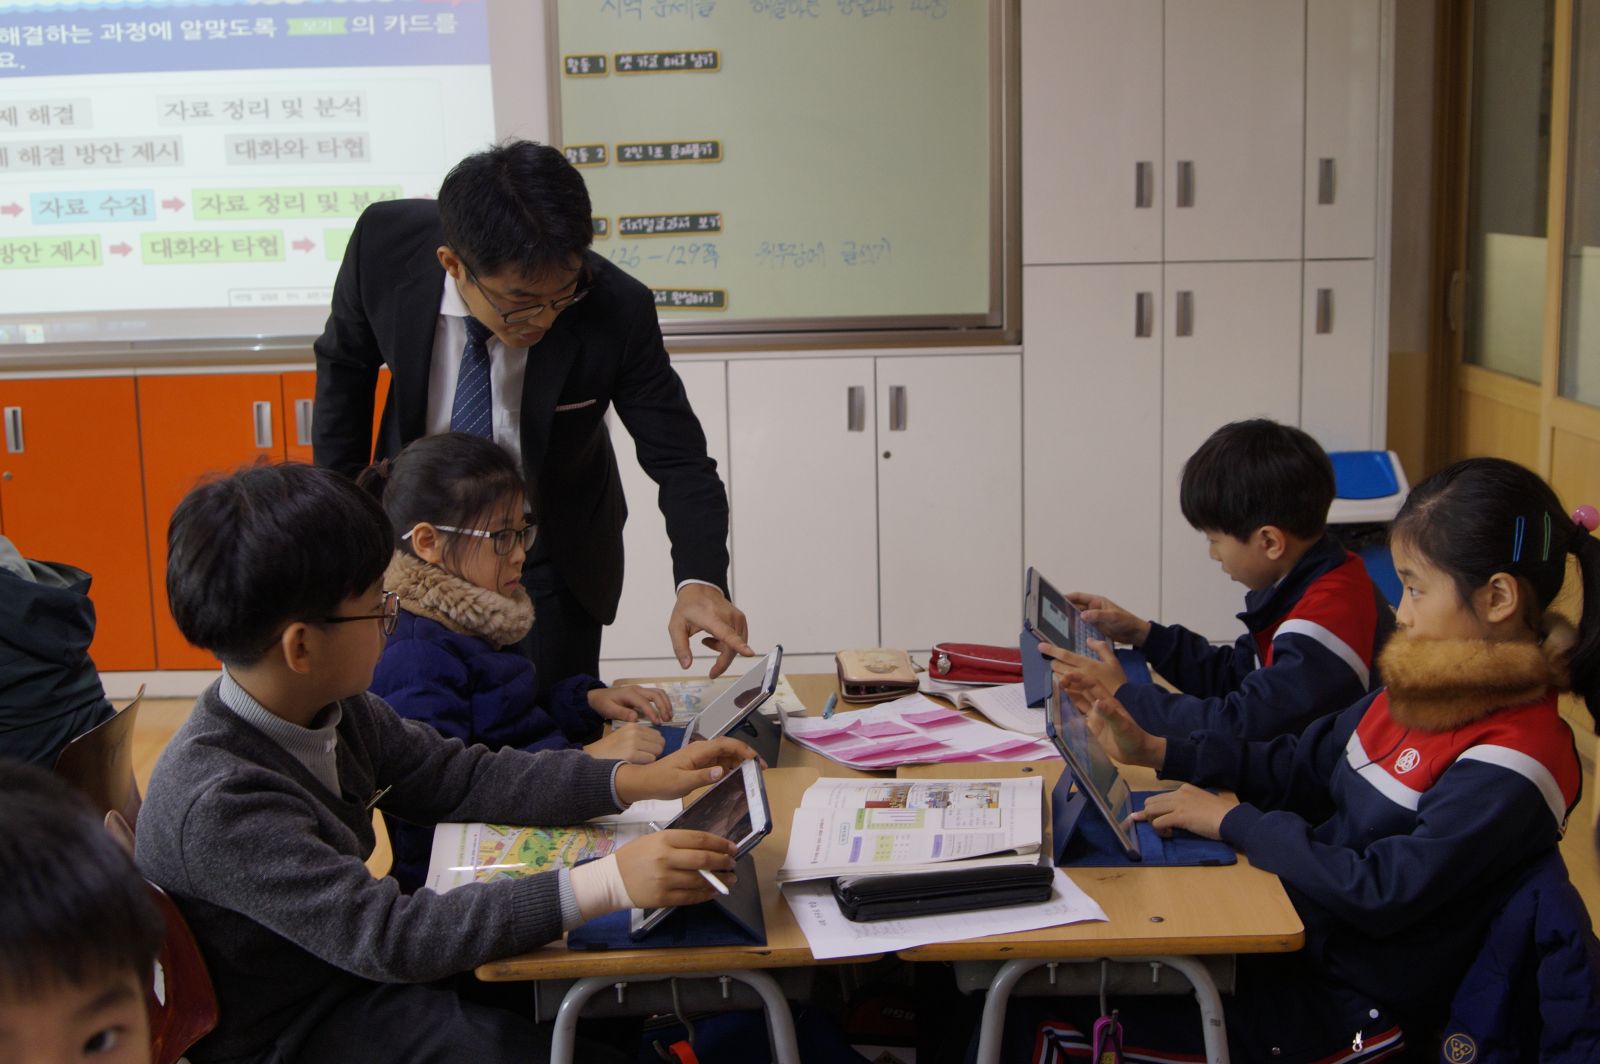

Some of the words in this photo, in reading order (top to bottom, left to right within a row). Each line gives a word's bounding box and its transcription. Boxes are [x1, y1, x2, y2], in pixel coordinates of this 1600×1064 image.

[0, 24, 93, 46] 해결하는
[100, 20, 173, 42] 과정에
[180, 18, 278, 40] 알맞도록
[352, 14, 375, 35] 의
[384, 13, 458, 35] 카드를
[26, 103, 75, 126] 해결
[164, 99, 214, 121] 자료
[222, 98, 270, 120] 정리
[281, 96, 304, 119] 및
[313, 95, 362, 118] 분석
[16, 144, 66, 167] 해결
[75, 142, 125, 165] 방안
[131, 139, 180, 163] 제시
[233, 137, 309, 160] 대화와
[316, 136, 365, 159] 타협
[596, 148, 605, 159] 2
[39, 197, 89, 219] 자료
[98, 194, 148, 217] 수집
[201, 194, 249, 216] 자료
[258, 192, 306, 215] 정리
[316, 191, 340, 213] 및
[0, 241, 42, 265] 방안
[50, 239, 97, 262] 제시
[149, 236, 225, 259] 대화와
[231, 234, 279, 258] 타협
